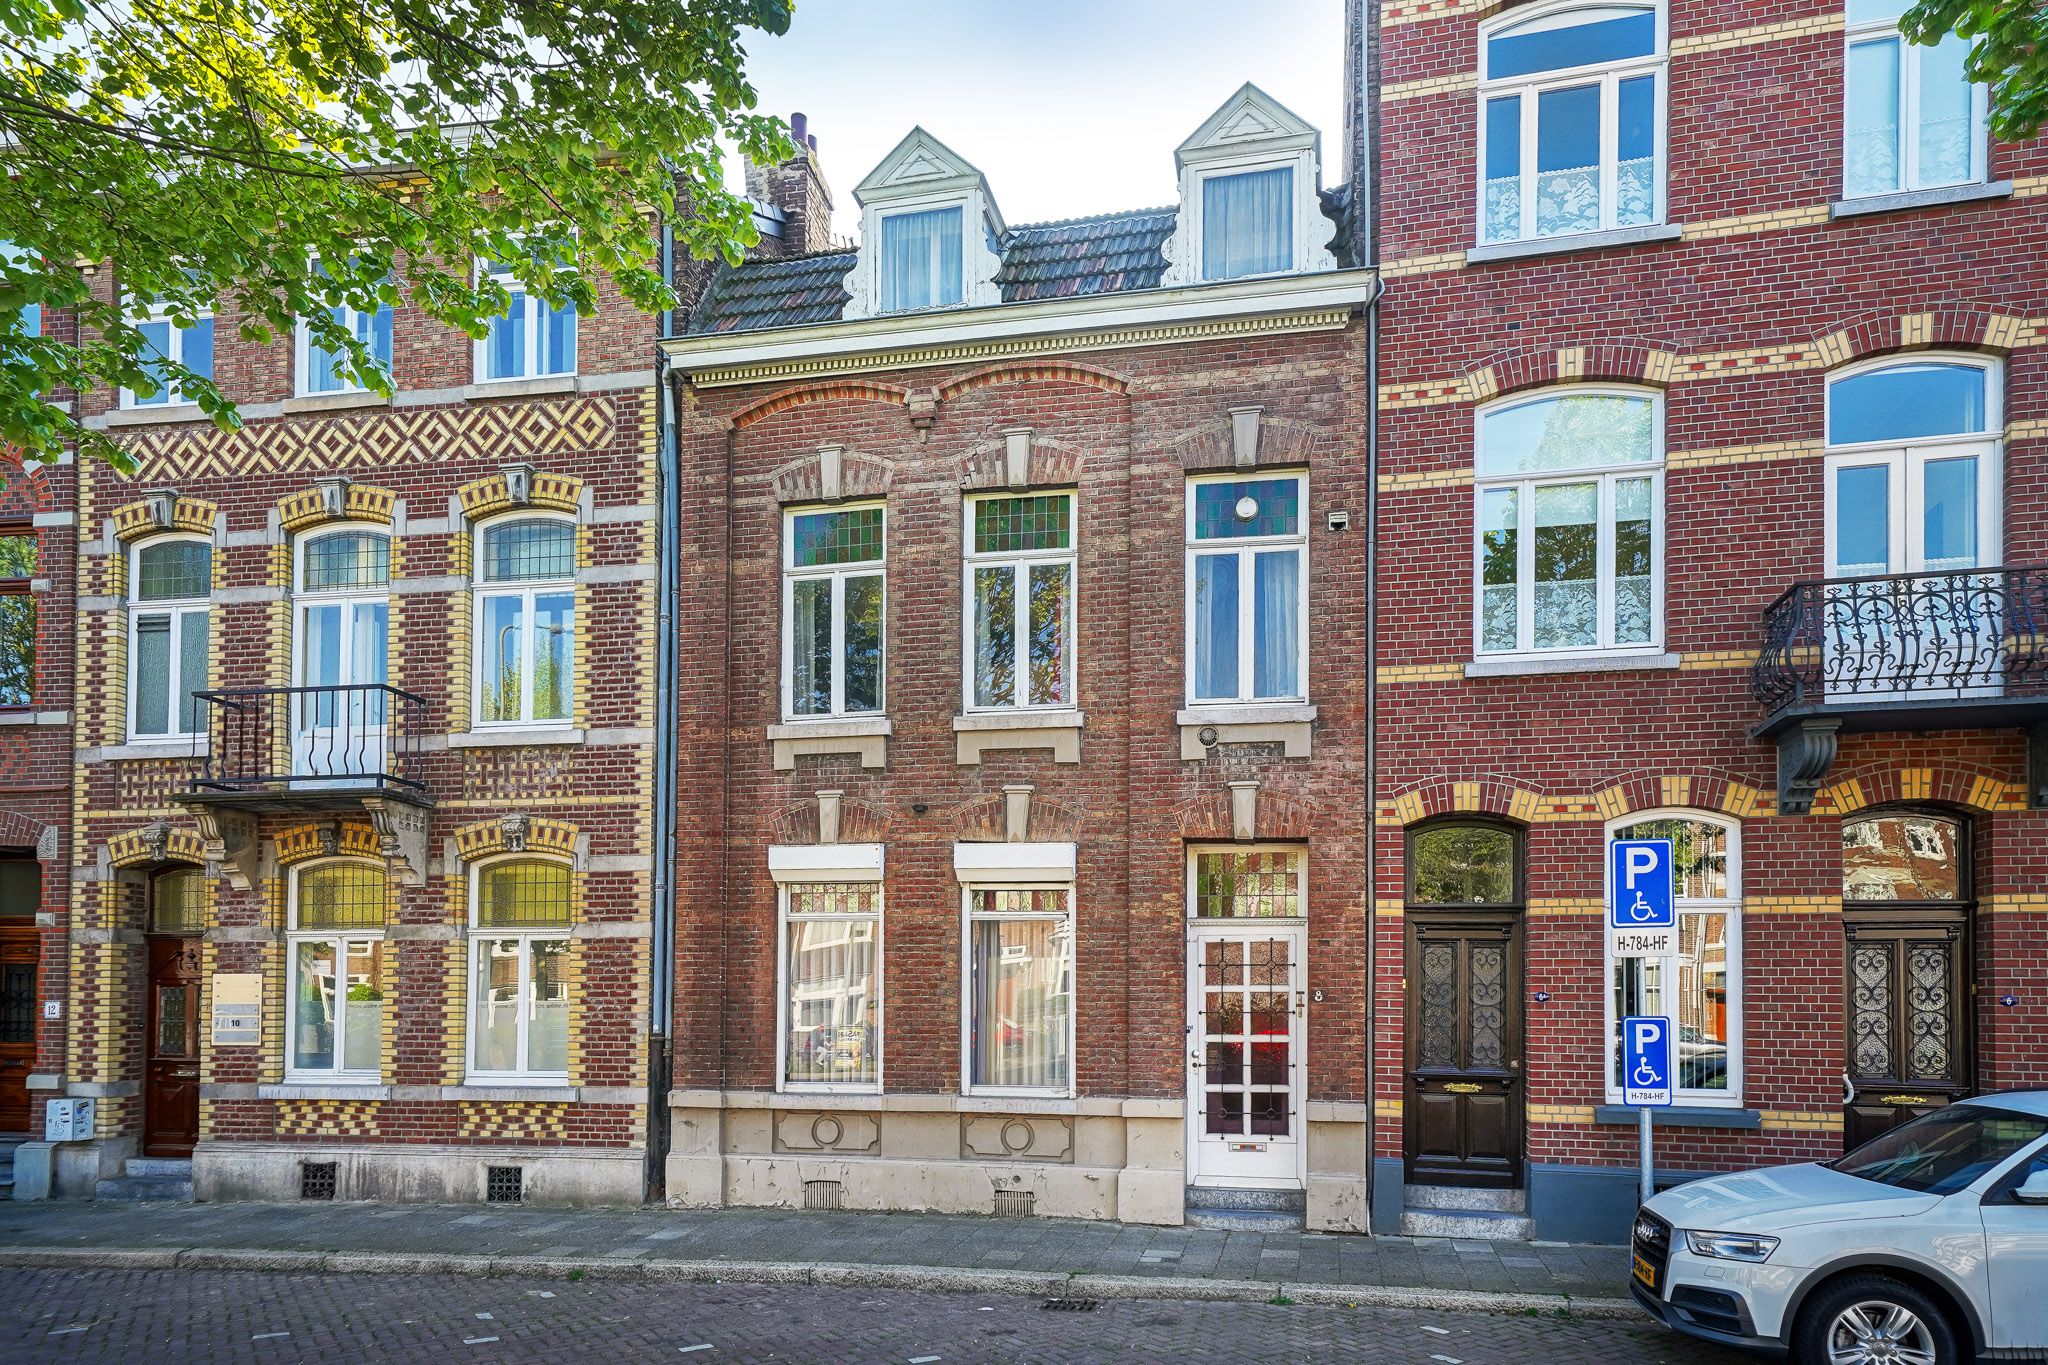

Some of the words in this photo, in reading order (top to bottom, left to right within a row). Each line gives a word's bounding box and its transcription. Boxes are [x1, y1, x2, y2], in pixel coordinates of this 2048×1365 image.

[1626, 847, 1658, 889] P
[1617, 935, 1668, 951] H-784-HF
[1314, 990, 1323, 1002] 8
[2006, 997, 2013, 1006] 6
[47, 1004, 56, 1015] 12
[230, 1019, 240, 1027] 10
[1635, 1023, 1661, 1054] P
[1631, 1092, 1665, 1100] H-784-HF
